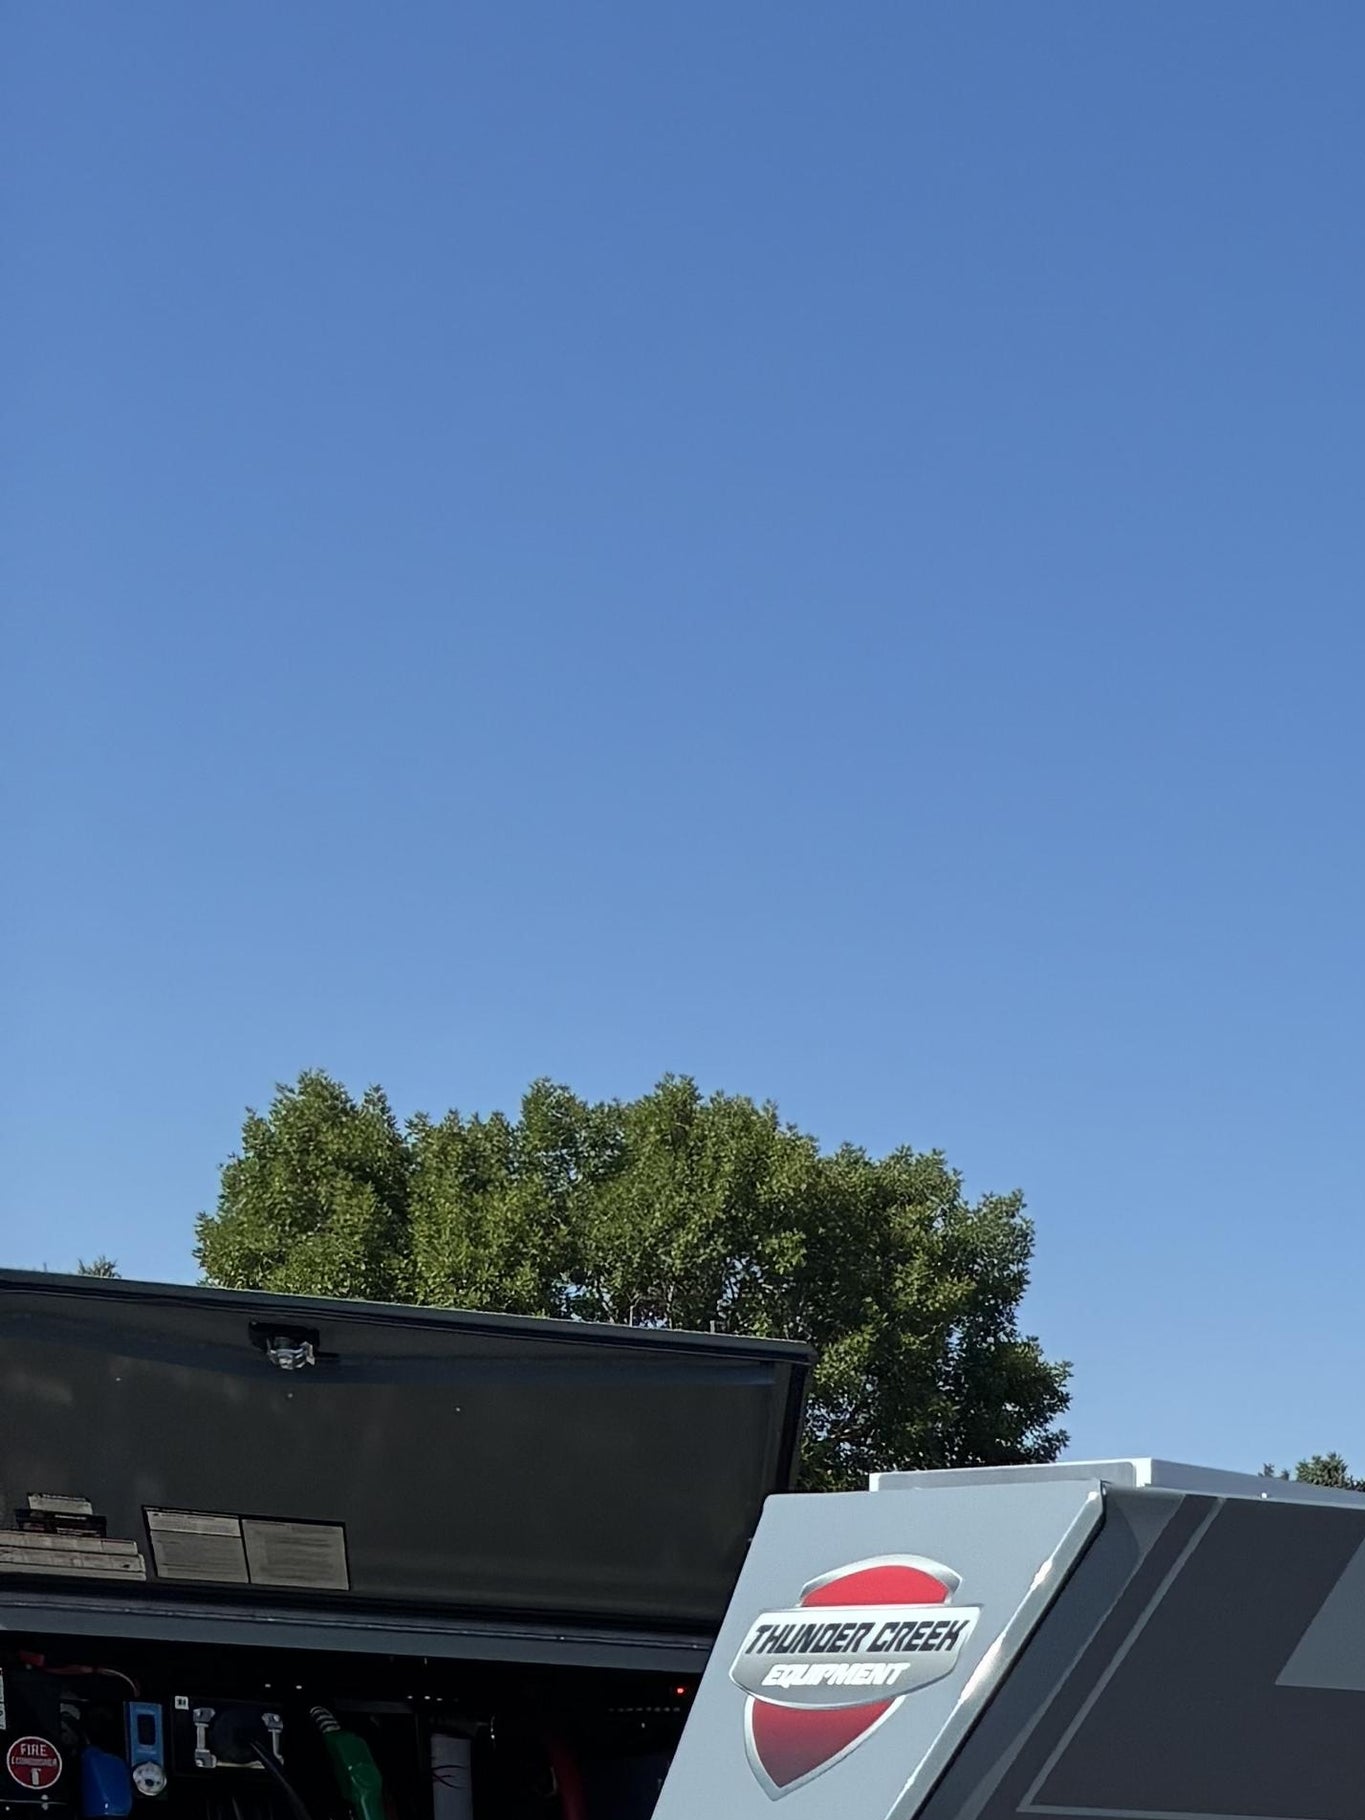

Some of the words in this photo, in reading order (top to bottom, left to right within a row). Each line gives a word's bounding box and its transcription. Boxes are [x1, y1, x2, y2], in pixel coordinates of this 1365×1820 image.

[745, 1621, 876, 1654] THUNDER
[865, 1619, 971, 1653] CREEK
[761, 1662, 911, 1688] EQUIPMENT
[20, 1743, 48, 1757] FIRE
